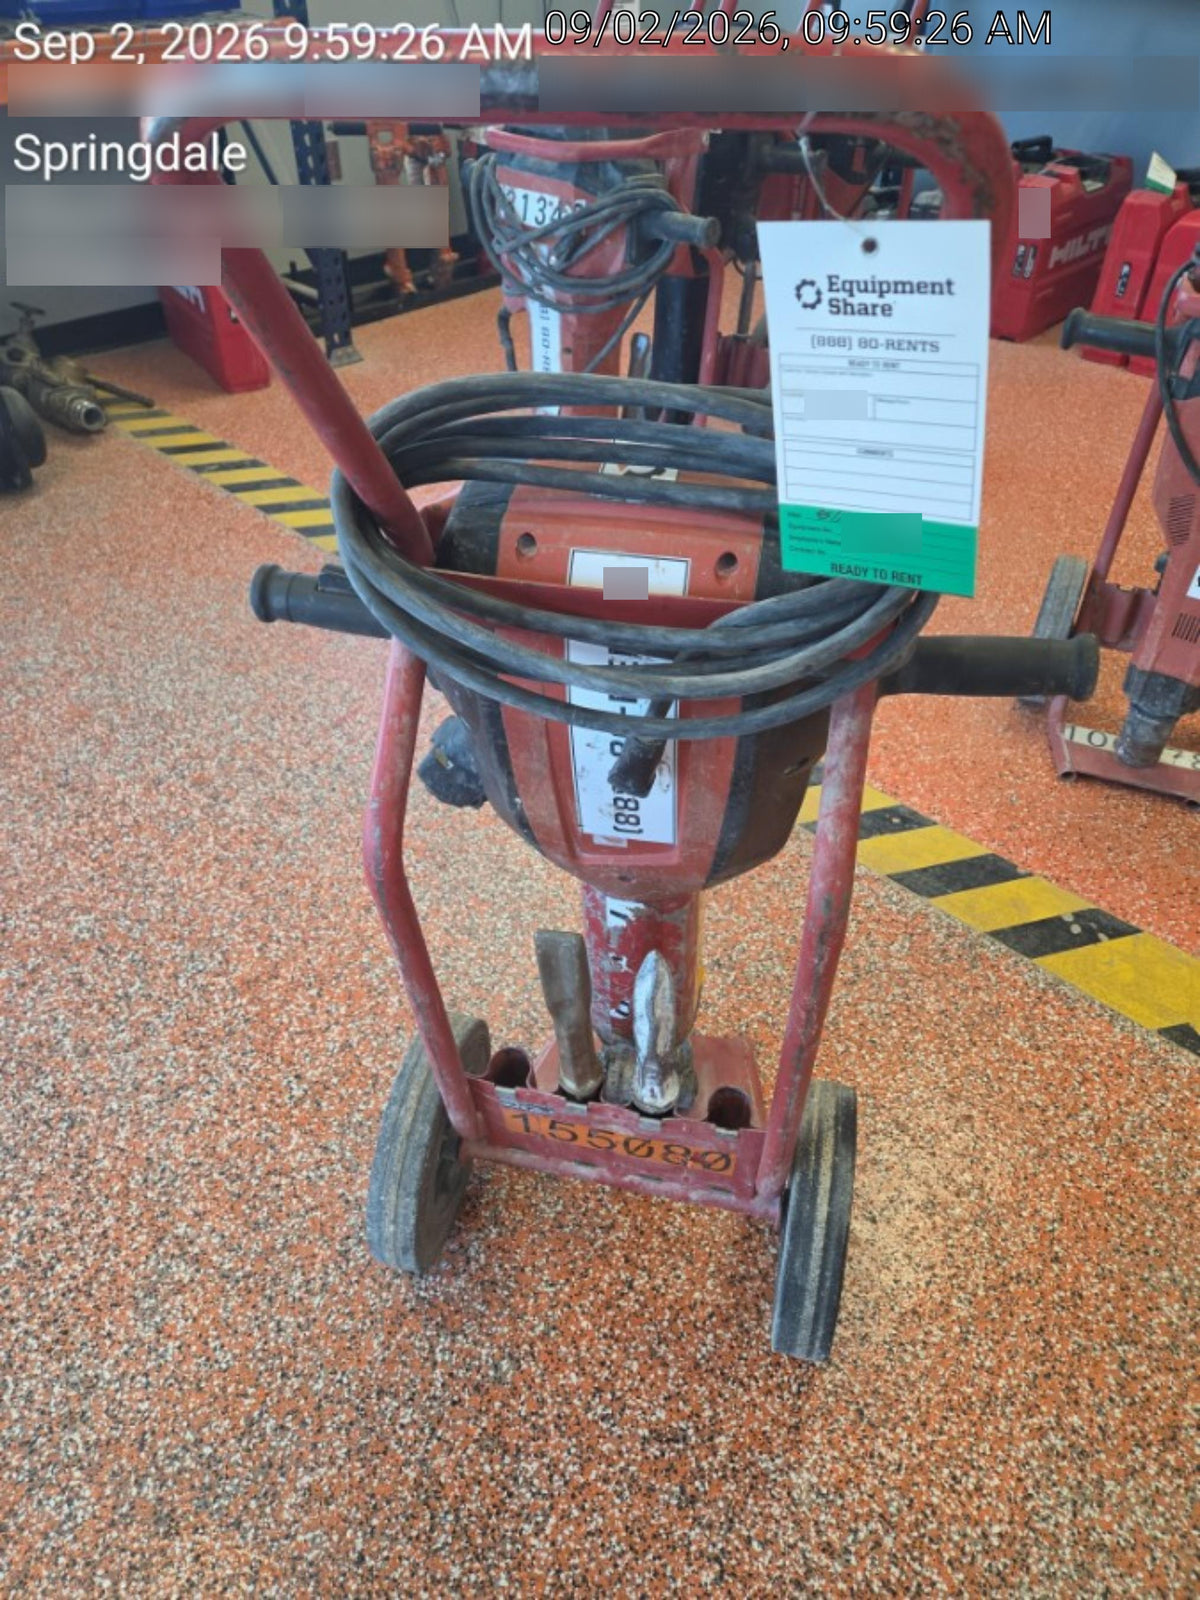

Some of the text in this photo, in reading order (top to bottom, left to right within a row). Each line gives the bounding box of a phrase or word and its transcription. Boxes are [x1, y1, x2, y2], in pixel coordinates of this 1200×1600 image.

[827, 275, 956, 298] Equipment
[828, 298, 894, 317] Share
[857, 336, 941, 353] 80-RENTS
[829, 563, 923, 586] READY TO RENT
[511, 1113, 732, 1172] 155080
